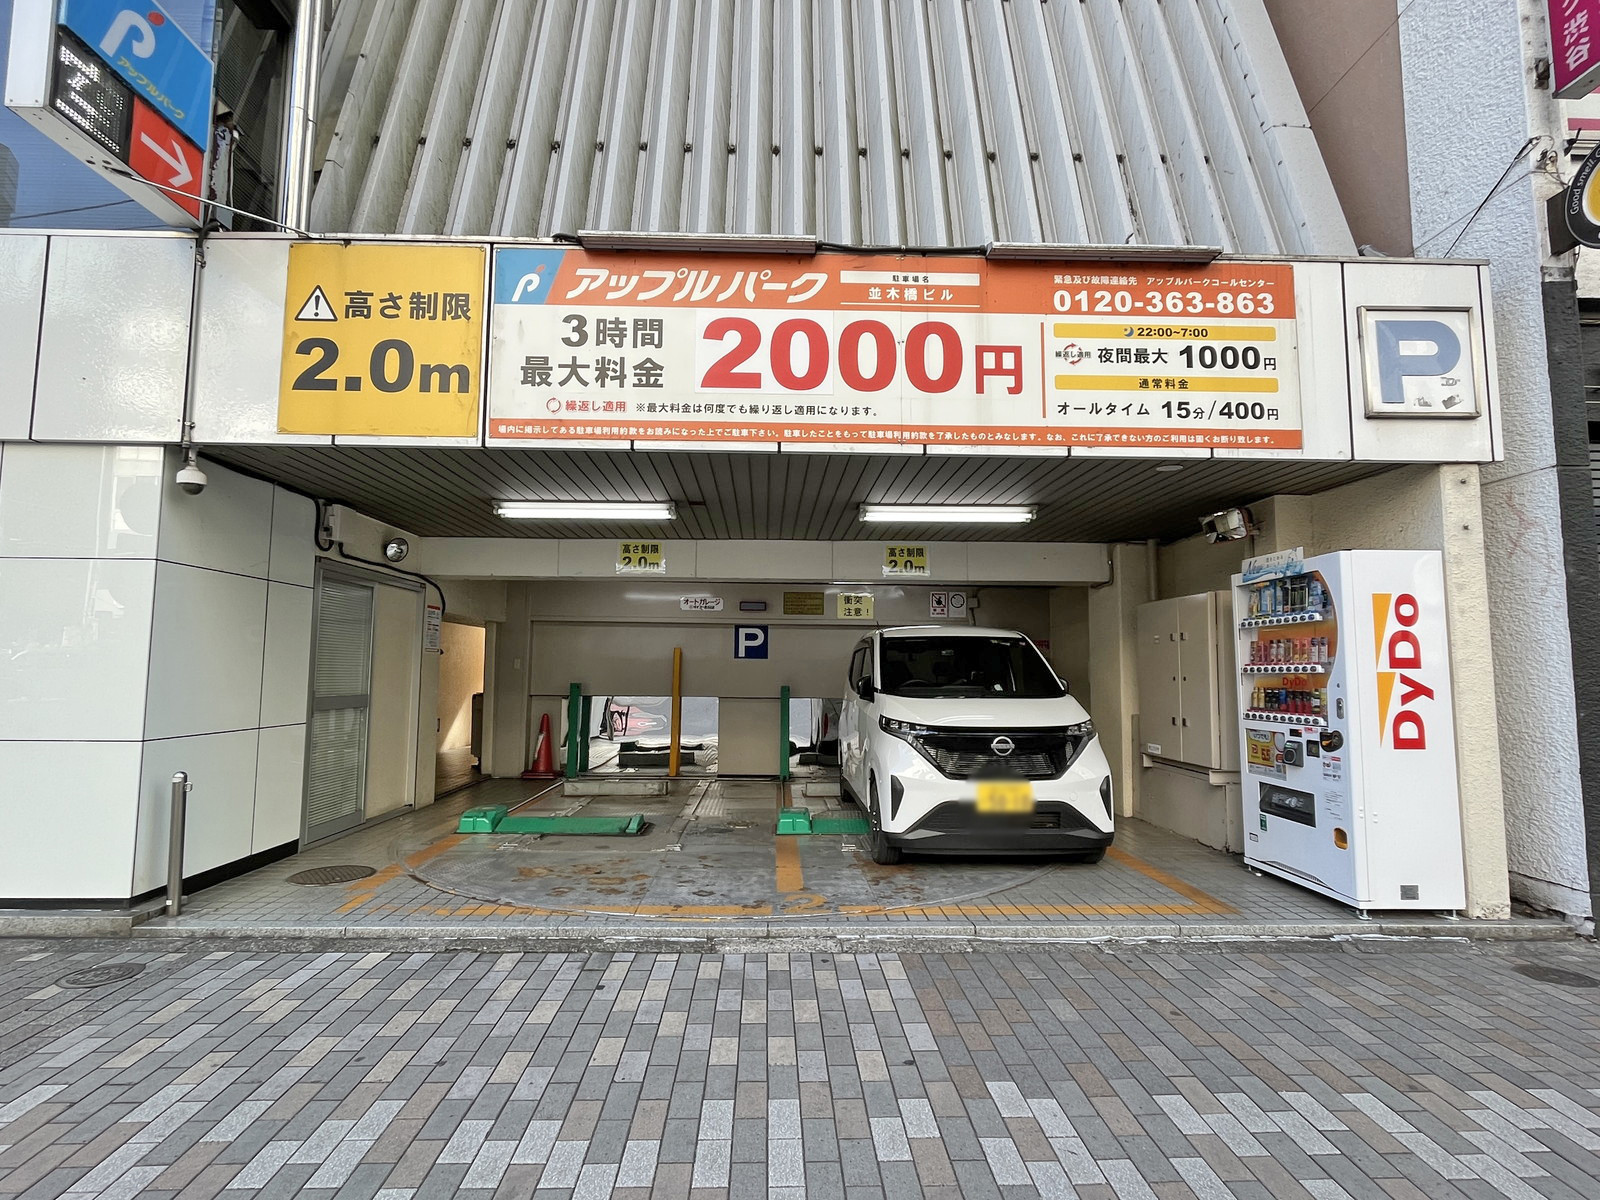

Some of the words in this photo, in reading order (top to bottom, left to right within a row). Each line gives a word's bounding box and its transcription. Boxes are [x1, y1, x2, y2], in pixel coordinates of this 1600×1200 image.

[1570, 188, 1581, 215] Good
[565, 267, 828, 304] アップルパーク
[892, 274, 929, 283] 駐車場名
[344, 291, 471, 321] 高さ制限
[868, 287, 953, 301] 並木橋ビル
[1053, 289, 1275, 314] 0120-363-863
[560, 314, 664, 349] 3時間
[291, 337, 470, 393] 2.0m
[700, 317, 1023, 394] 2000円
[1097, 348, 1168, 364] 夜間最大
[1179, 345, 1277, 370] 1000円
[1375, 320, 1461, 404] P
[520, 356, 664, 389] 最大料金
[1138, 378, 1189, 389] 通常料金
[565, 400, 626, 412] 繰返し適用
[1057, 402, 1150, 416] オールタイム
[622, 544, 659, 554] 高さ制限
[888, 547, 924, 557] 高さ制限
[621, 556, 660, 570] 2.0m
[888, 559, 925, 573] 2.0m
[843, 596, 863, 605] 衝突
[738, 628, 764, 657] P
[1282, 677, 1307, 689] DyDo
[1388, 593, 1434, 750] DyDo
